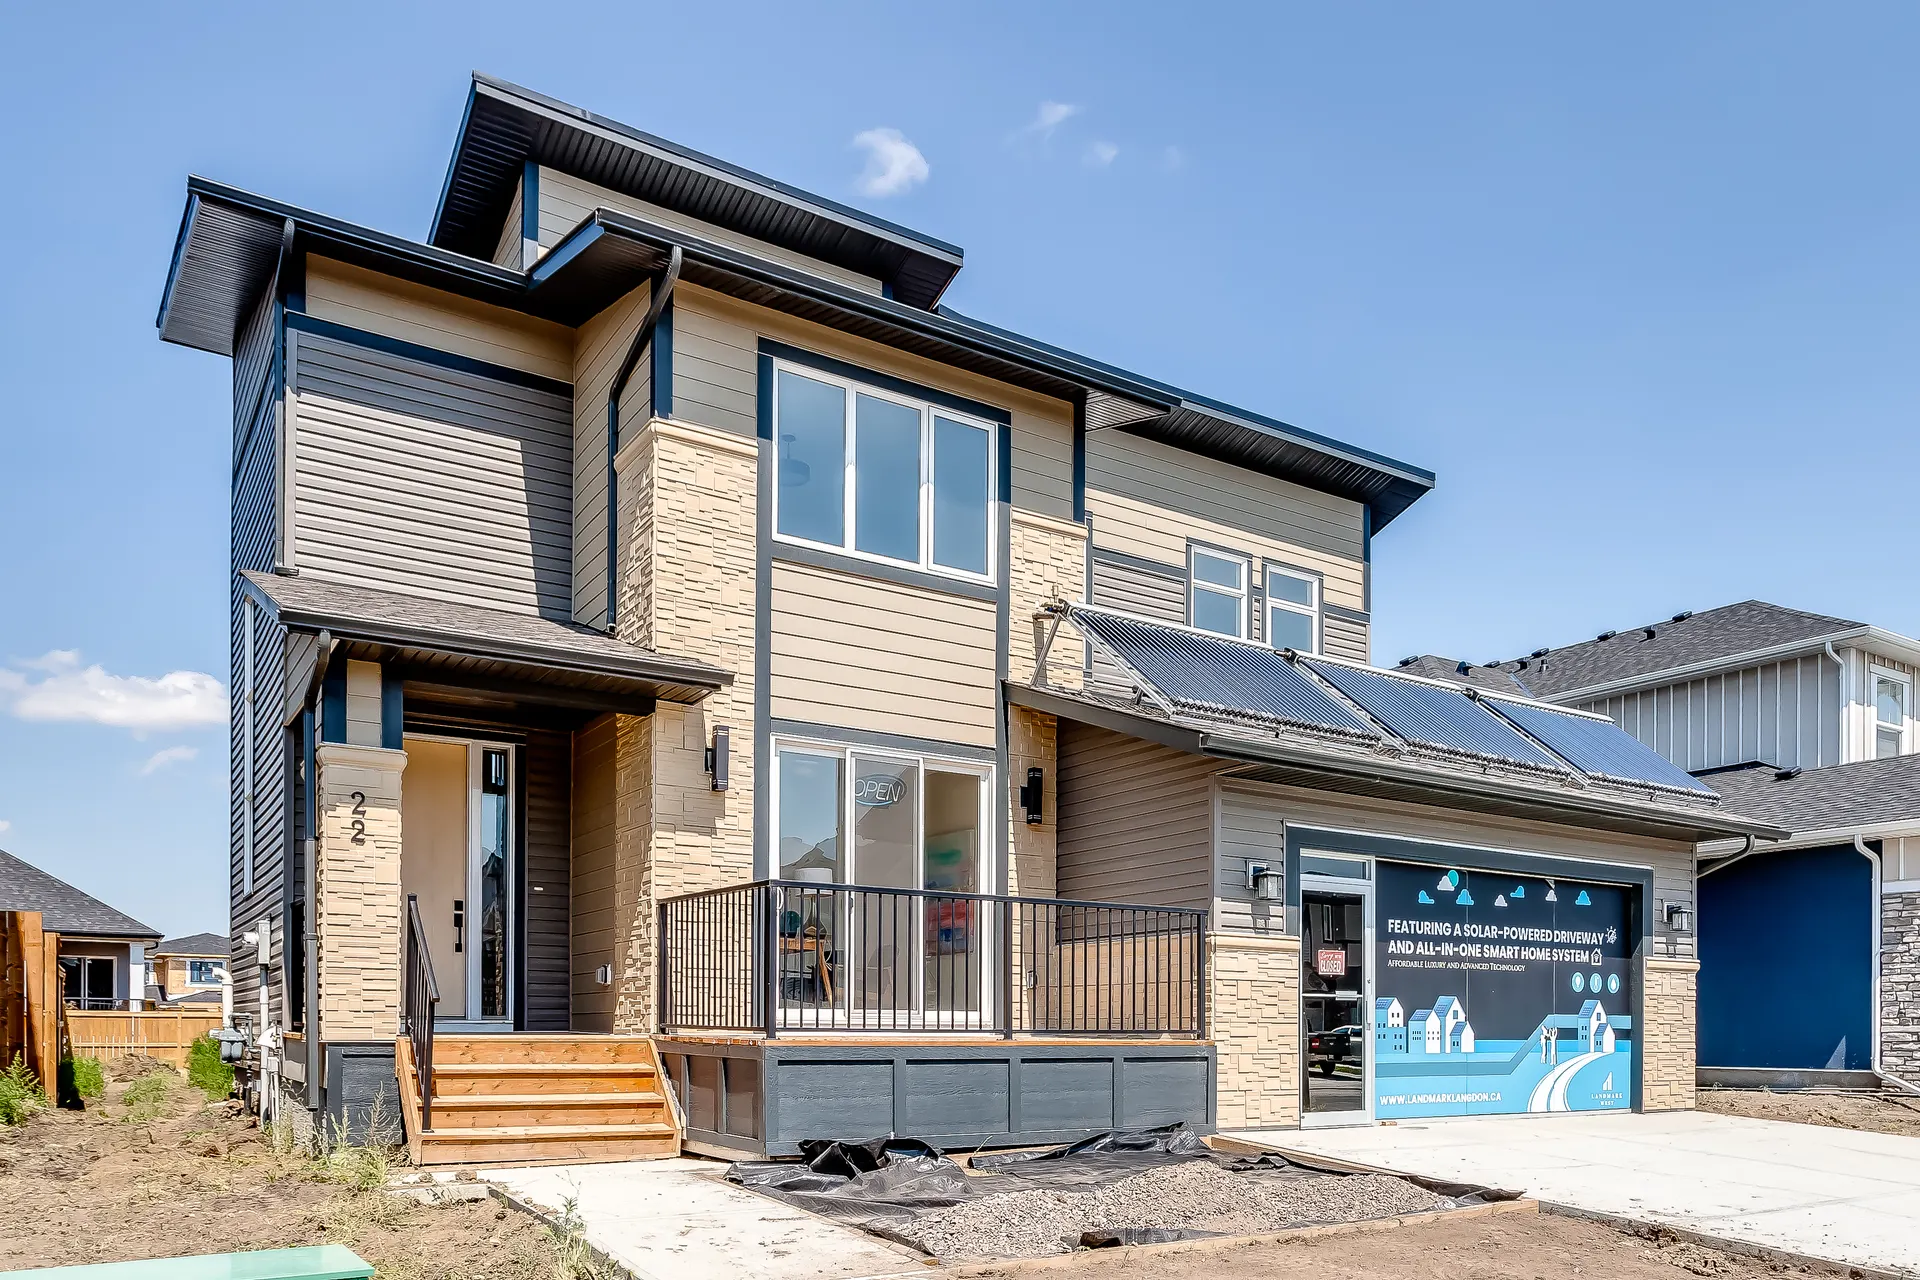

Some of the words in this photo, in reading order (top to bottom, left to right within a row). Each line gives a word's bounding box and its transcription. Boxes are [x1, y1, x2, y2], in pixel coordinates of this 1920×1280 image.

[855, 779, 901, 802] OPEN
[350, 791, 367, 846] 22
[1387, 919, 1452, 936] FEATURING
[1453, 923, 1462, 937] A
[1463, 924, 1552, 942] SOLAR-POWERED
[1553, 930, 1604, 945] DRIVEWAY
[1387, 940, 1415, 955] AND
[1416, 941, 1482, 957] ALL-IN-ONE
[1483, 945, 1520, 959] SMART
[1520, 946, 1551, 961] HOME
[1552, 948, 1590, 963] SYSTEM
[1320, 960, 1342, 973] CLOSED
[1379, 1092, 1502, 1106] WWW.LANDMARKLANGDON.CA
